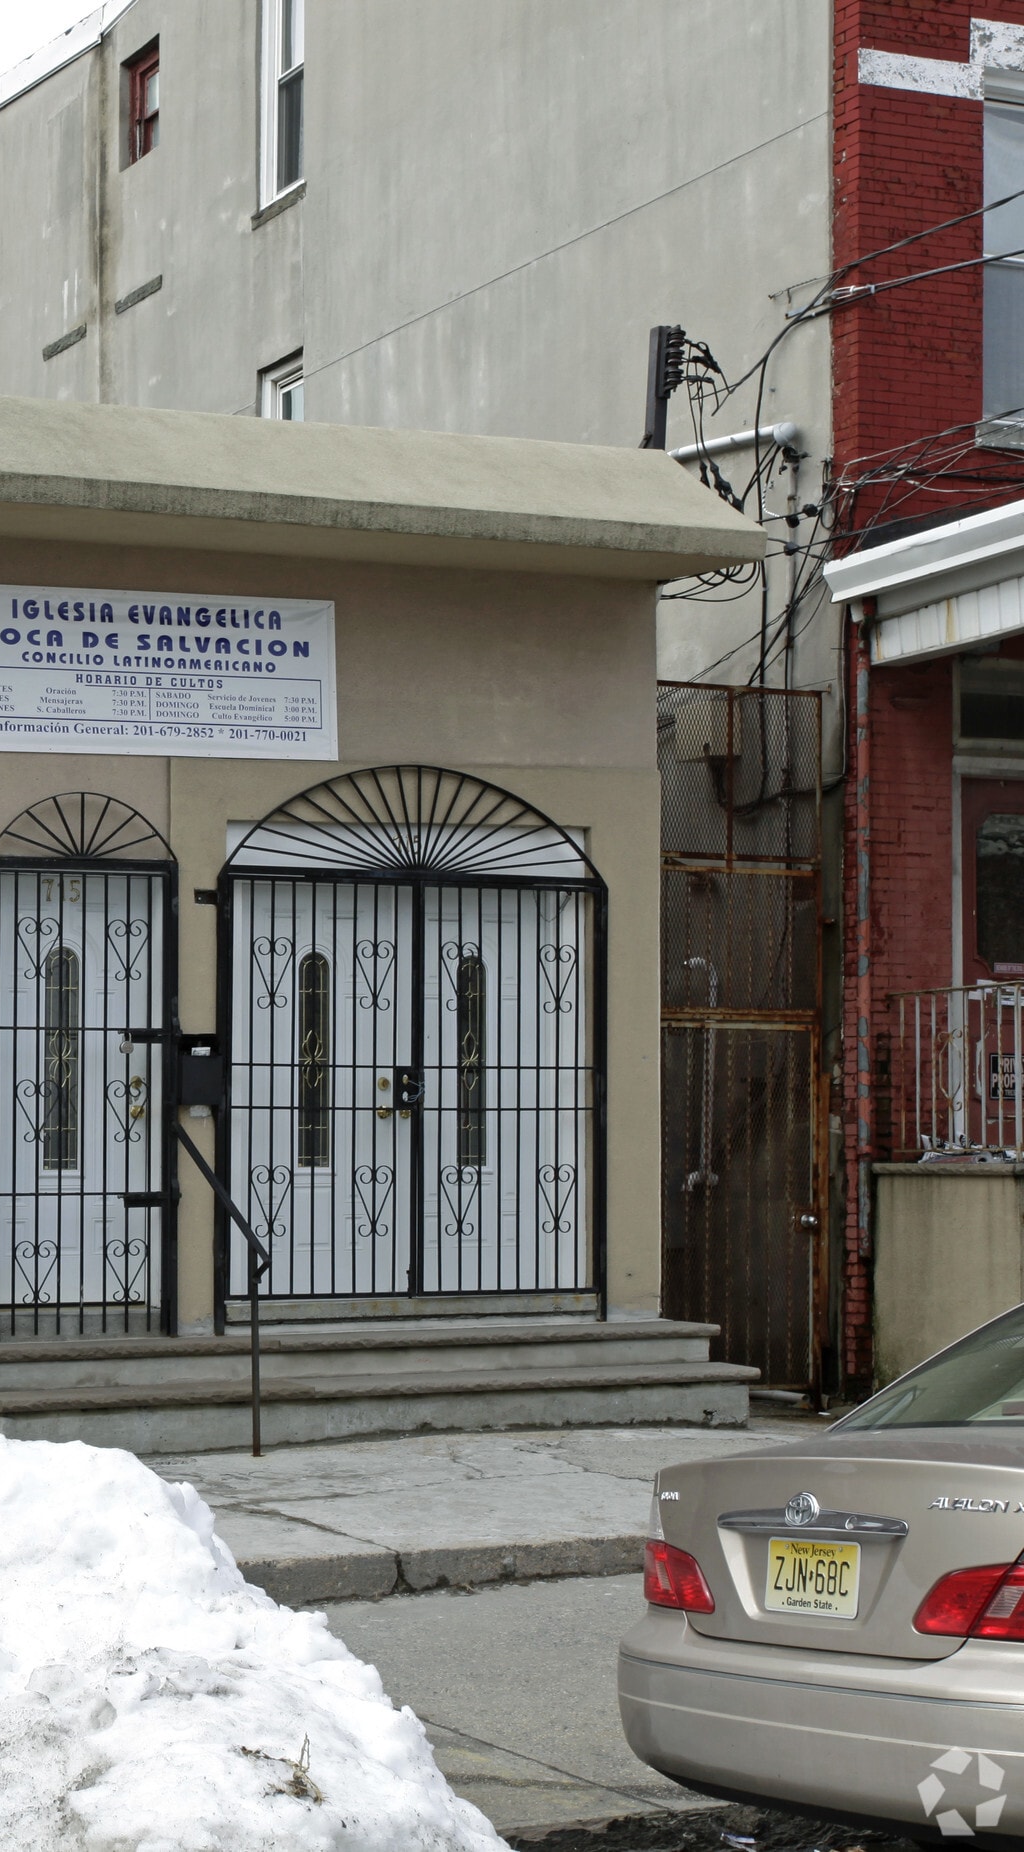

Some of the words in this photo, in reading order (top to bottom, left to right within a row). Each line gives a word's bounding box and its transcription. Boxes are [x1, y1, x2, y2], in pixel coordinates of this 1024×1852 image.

[11, 598, 114, 623] IGLESIA
[128, 604, 282, 630] EVANGELICA
[82, 631, 119, 649] DE
[137, 634, 310, 658] SALVACION
[21, 651, 104, 666] CONCILIO
[113, 655, 276, 673] LATINOAMERICANO
[75, 673, 137, 686] HORARIO
[145, 676, 162, 687] DE
[170, 677, 224, 689] CULTOS
[45, 686, 77, 695] Oración
[112, 689, 128, 698] 7:30
[129, 690, 147, 698] P.M.
[155, 691, 192, 700] SABADO
[207, 694, 237, 702] Servicio
[238, 695, 247, 703] de
[248, 695, 277, 703] Jovenes
[284, 696, 299, 704] 7:30
[300, 697, 317, 705] P.M.
[40, 696, 83, 706] Mensajeras
[112, 699, 128, 707] 7:30
[129, 699, 147, 707] P.M.
[155, 701, 200, 710] DOMINGO
[209, 703, 237, 711] Escuela
[238, 704, 275, 713] Dominical
[284, 706, 299, 714] 3:00
[300, 706, 317, 714] P.M.
[46, 706, 87, 715] Caballeros
[112, 708, 128, 717] 7:30
[129, 709, 147, 717] P.M.
[155, 710, 200, 719] DOMINGO
[211, 712, 233, 720] Culto
[233, 713, 273, 723] Evangélico
[284, 715, 300, 723] 5:00
[301, 716, 318, 724] P.M.
[73, 722, 130, 736] General:
[133, 725, 215, 739] 201-679-2852
[229, 728, 307, 742] 201-770-0021
[927, 1496, 1010, 1513] AVALON
[791, 1543, 809, 1555] New
[810, 1544, 837, 1559] Jersey
[786, 1596, 812, 1608] Garden
[813, 1599, 833, 1610] State
